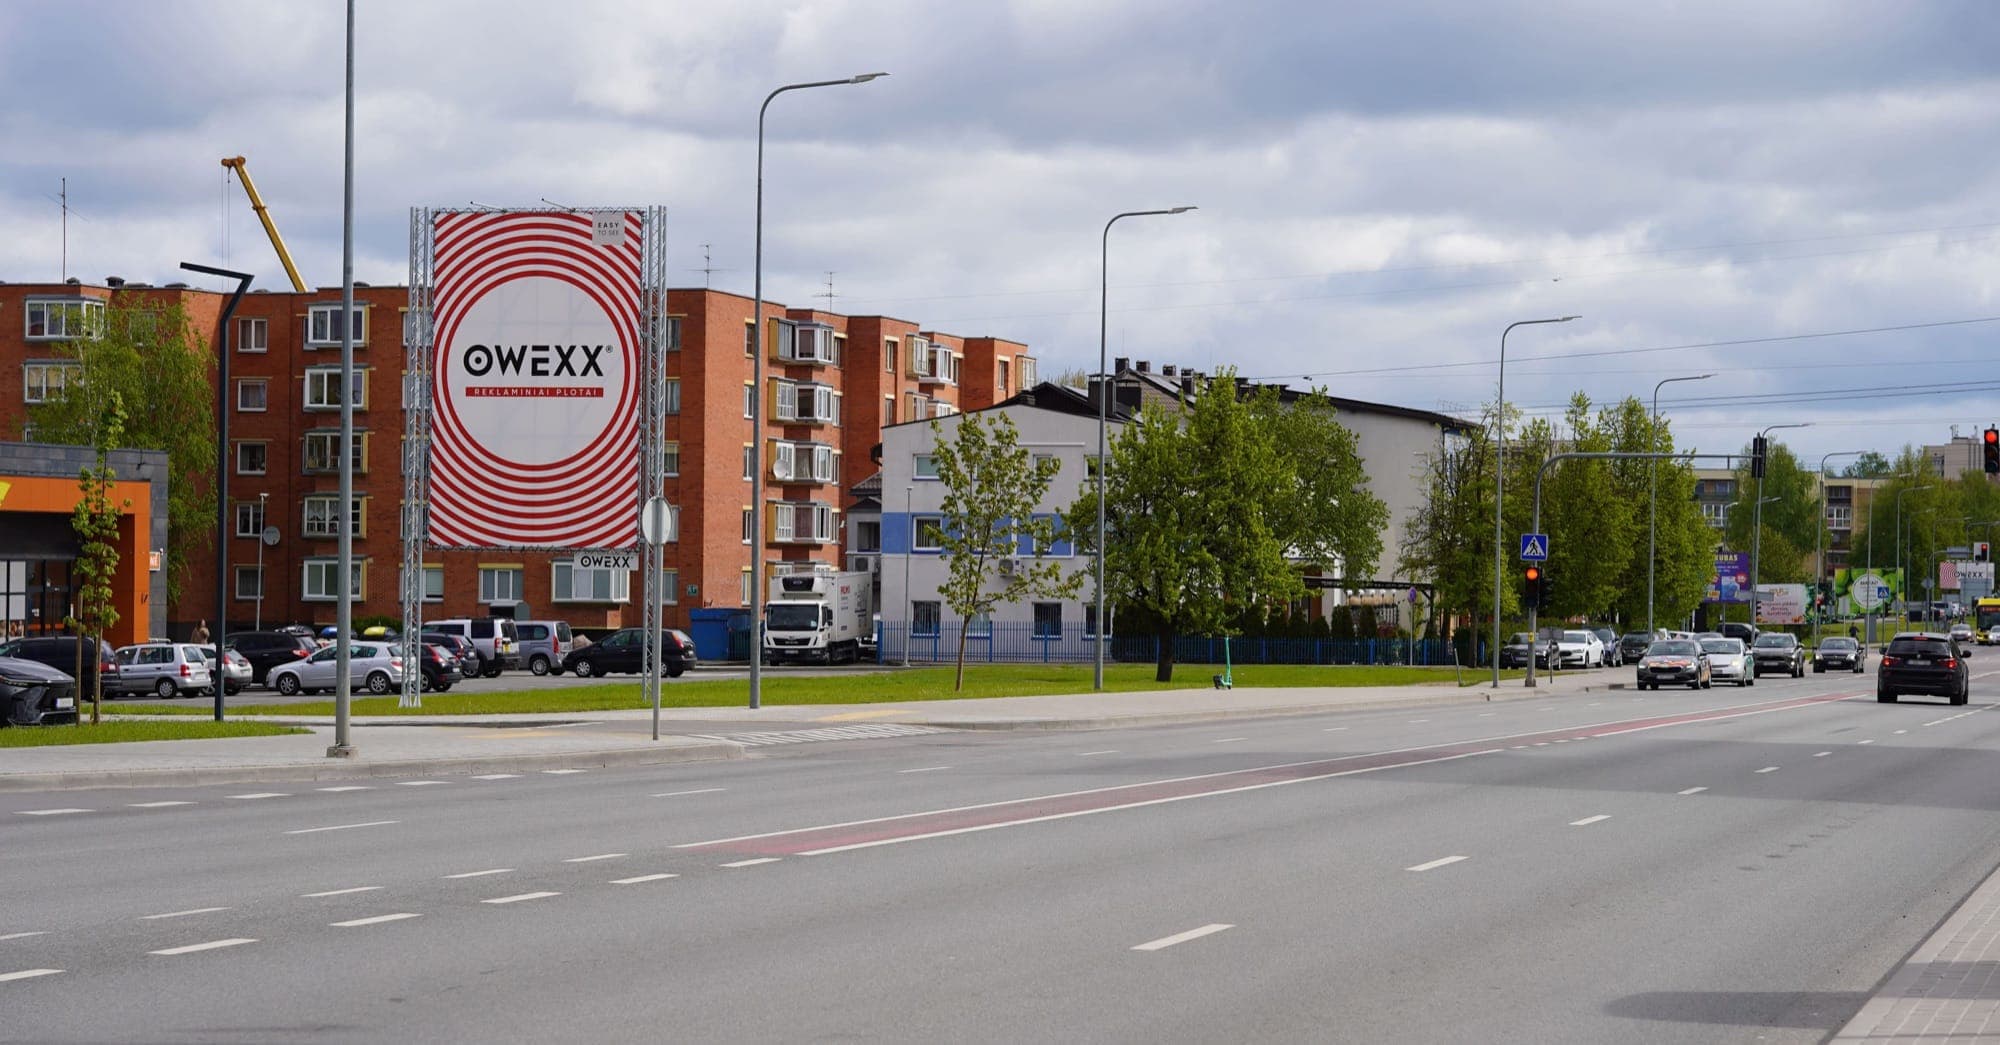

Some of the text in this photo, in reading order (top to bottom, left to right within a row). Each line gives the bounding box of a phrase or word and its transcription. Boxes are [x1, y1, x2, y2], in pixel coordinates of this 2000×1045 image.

[474, 388, 597, 396] REKLAMINIAI PLOTAI
[580, 555, 630, 568] OWEXX
